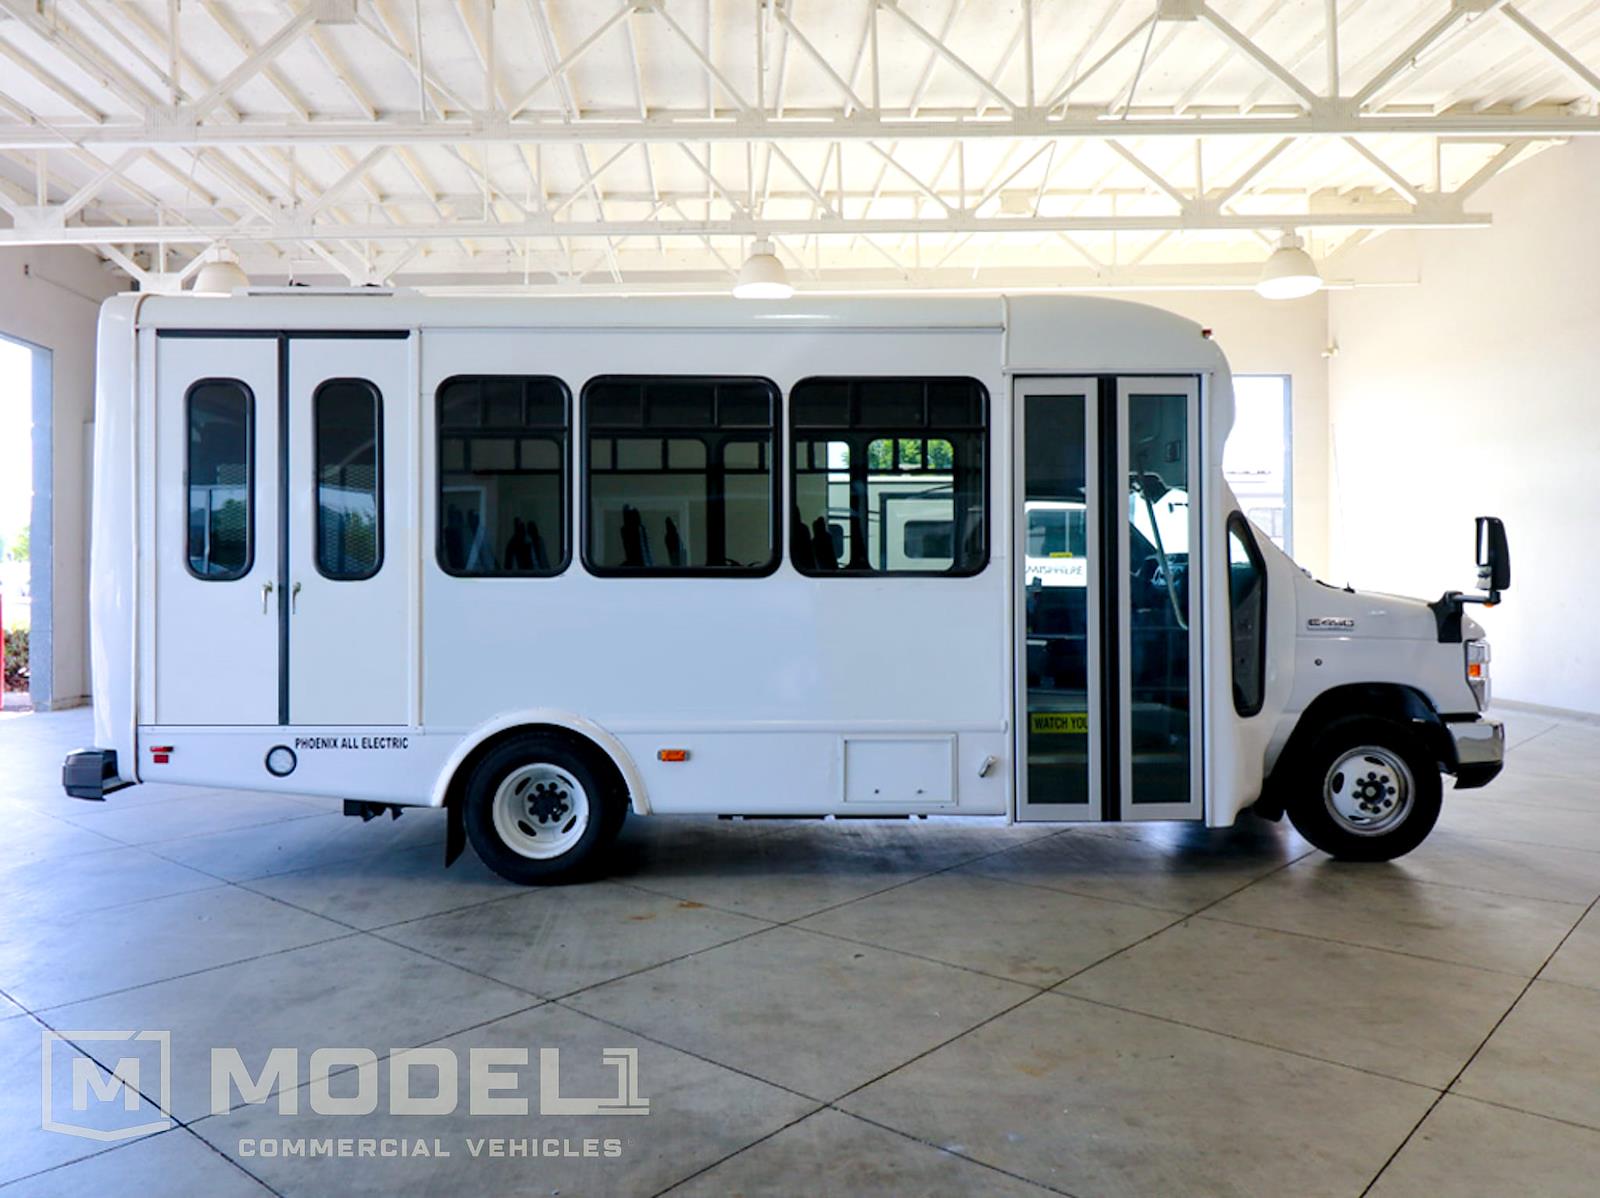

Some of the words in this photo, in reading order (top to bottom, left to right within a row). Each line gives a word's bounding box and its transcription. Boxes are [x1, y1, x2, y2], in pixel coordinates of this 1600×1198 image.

[1034, 716, 1069, 730] WATCH
[295, 737, 338, 750] PHOENIX
[340, 738, 359, 750] ALL
[361, 737, 409, 750] ELECTRIC
